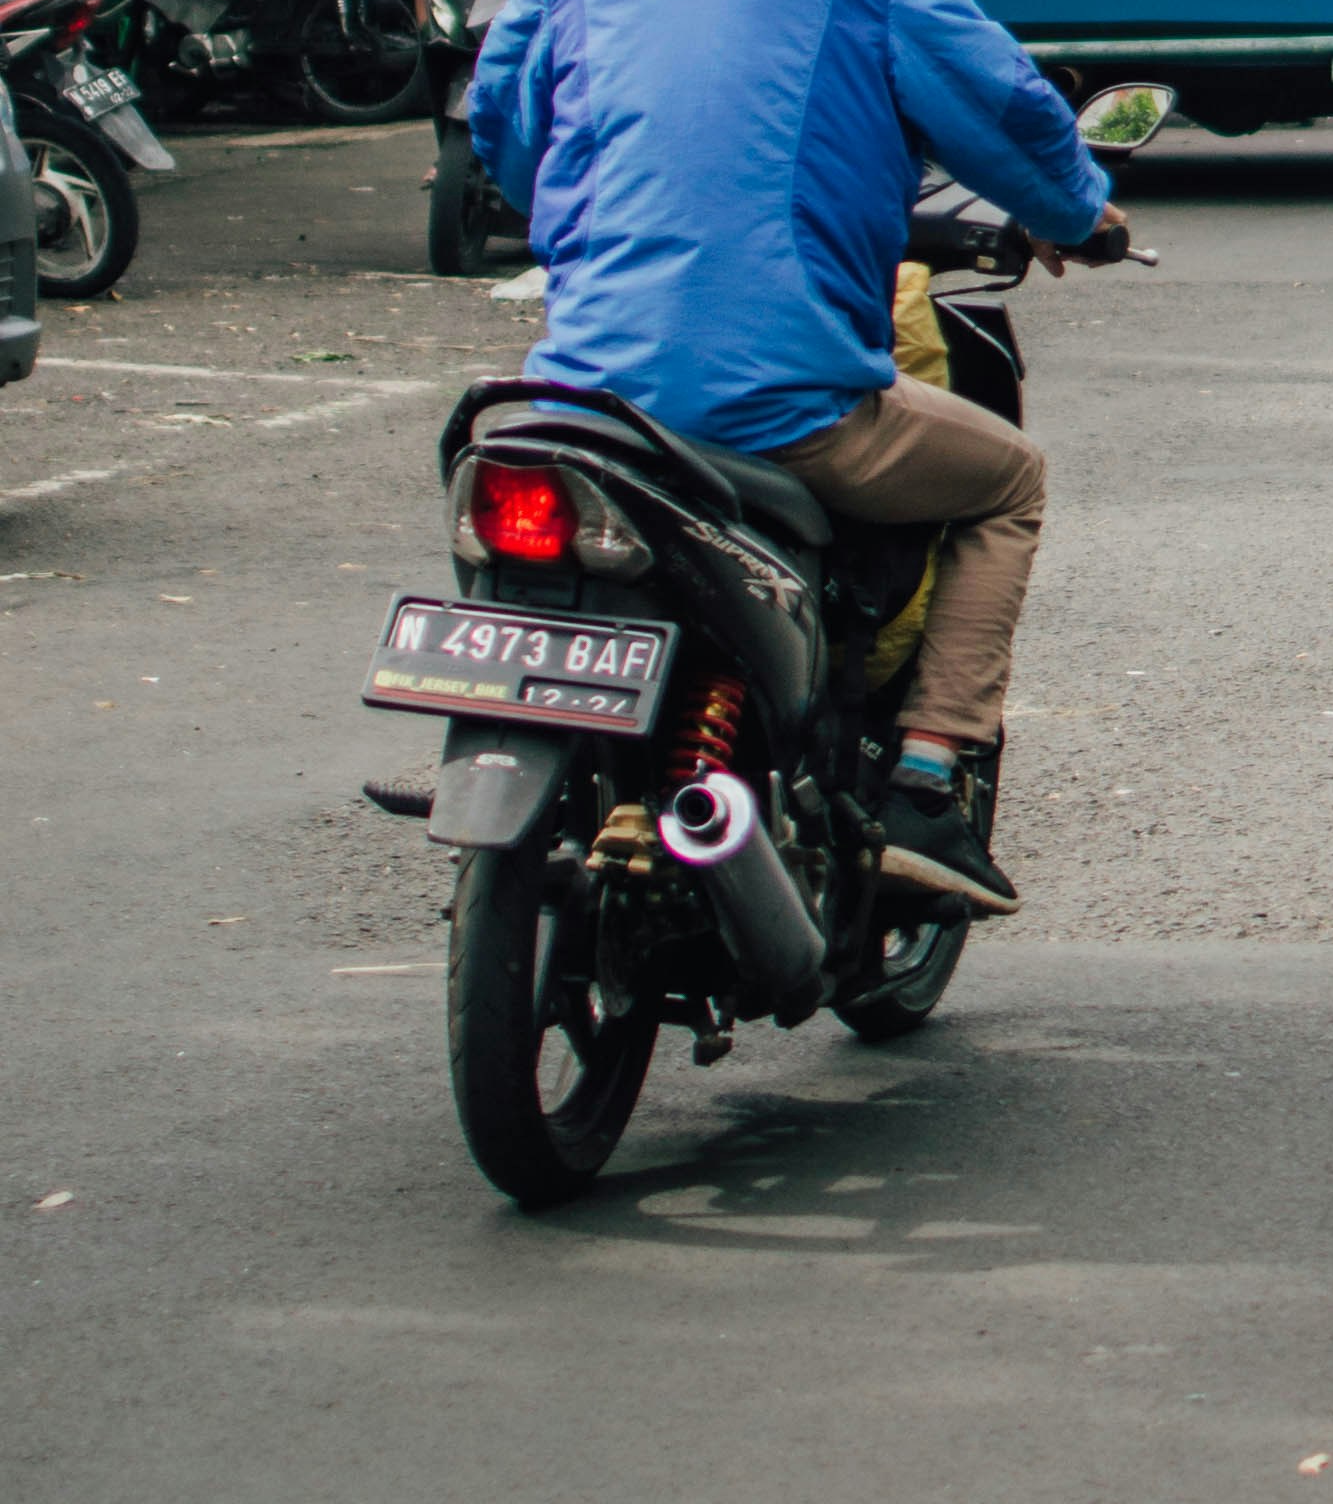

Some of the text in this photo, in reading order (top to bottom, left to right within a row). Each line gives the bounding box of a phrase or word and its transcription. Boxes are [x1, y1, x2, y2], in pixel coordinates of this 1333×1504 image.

[398, 614, 650, 678] N 4973 BAF
